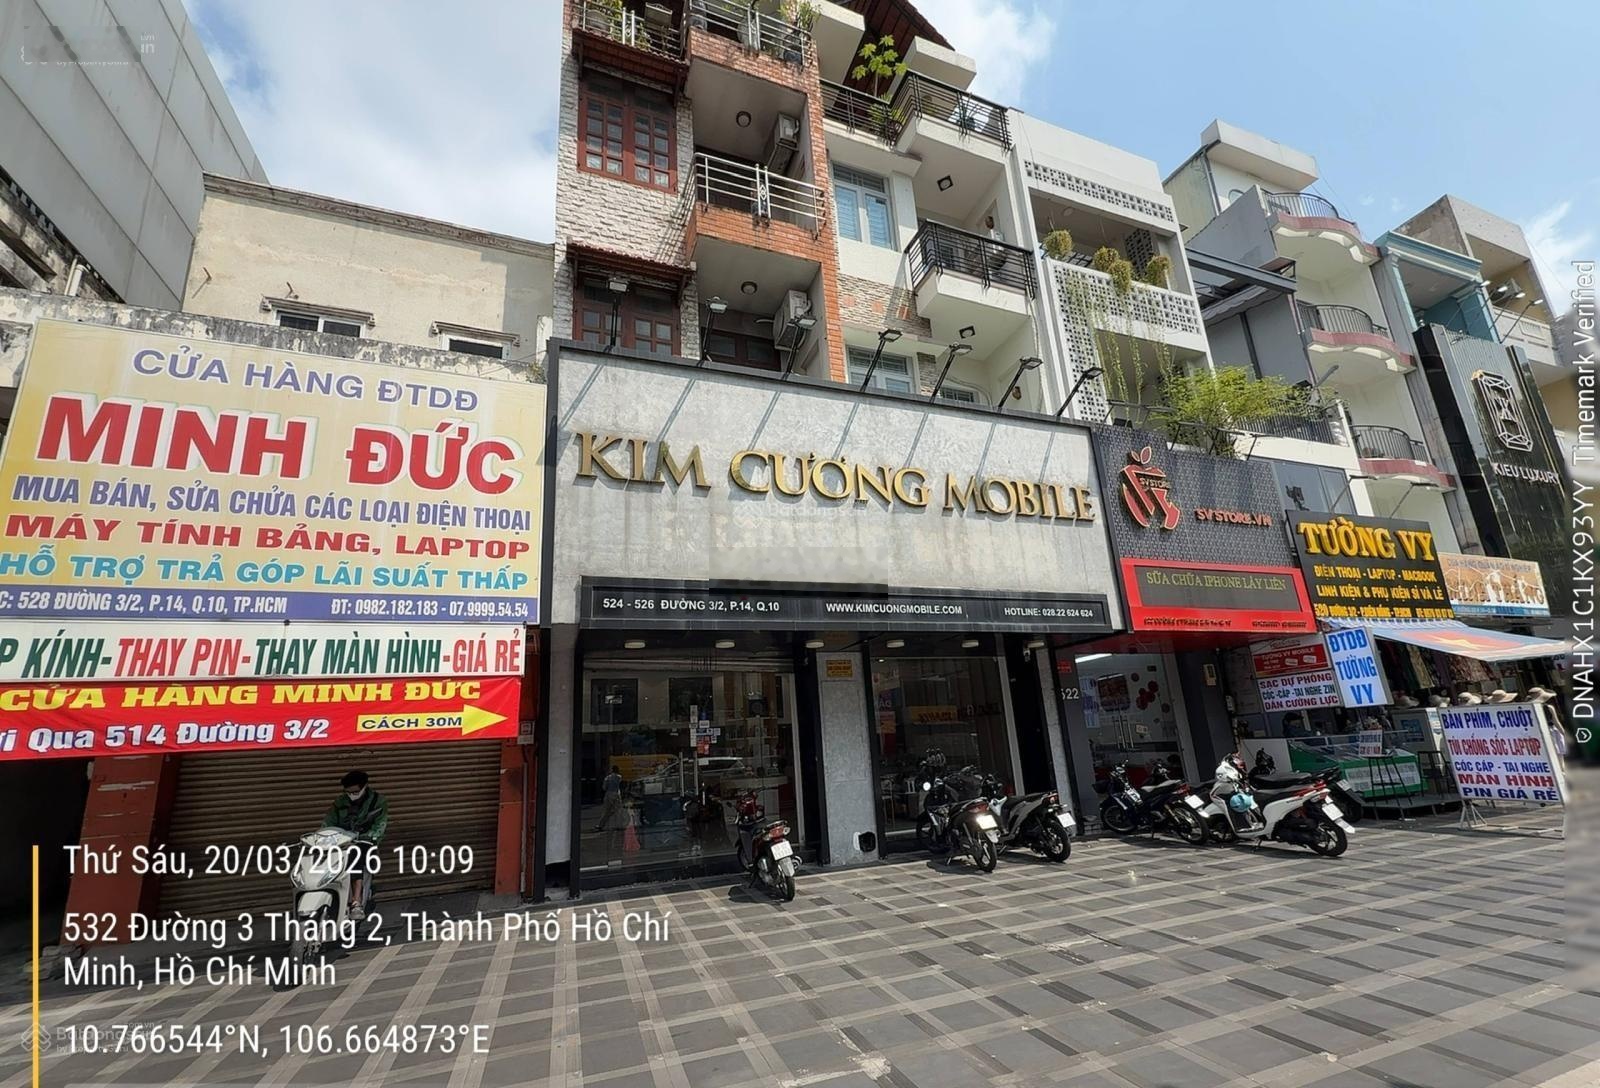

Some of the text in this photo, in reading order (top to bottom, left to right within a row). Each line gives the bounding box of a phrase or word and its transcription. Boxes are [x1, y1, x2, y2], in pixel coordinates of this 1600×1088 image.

[133, 344, 478, 411] CỬA HÀNG ĐTDĐ
[37, 396, 515, 495] MINH ĐỨC
[576, 432, 711, 488] KIM
[943, 473, 1096, 522] MOBILE
[12, 475, 80, 504] MUA
[89, 477, 156, 512] BÁN,
[167, 479, 220, 513] SỬA
[305, 492, 353, 521] CÁC
[360, 499, 410, 528] LOẠI
[416, 500, 466, 531] ĐIỆN
[474, 507, 531, 535] THOẠI
[5, 513, 530, 559] MÁY TÍNH BẢNG, LAPTOP
[1394, 530, 1435, 561] VY
[0, 545, 528, 590] HỖ TRỢ TRẢ GÓP LÃI SUẤT THẤP
[1367, 568, 1396, 581] LAPTOP
[17, 592, 50, 610] 528
[54, 589, 111, 612] ĐƯỜNG
[116, 594, 145, 614] 3/2,
[149, 595, 187, 614] P.14,
[191, 596, 228, 615] Q.10,
[234, 596, 288, 614] TP.HCM
[331, 599, 352, 615] ĐT:
[354, 599, 438, 616] 0982.182.183
[449, 601, 529, 617] 07.9999.54.54
[602, 598, 624, 609] 524
[634, 599, 655, 610] 526
[660, 597, 705, 610] ĐƯỜNG
[708, 600, 727, 612] 3/2,
[730, 601, 754, 613] P.14,
[756, 602, 780, 612] Q.10
[826, 603, 963, 615] WWW.KIMCUONGMOBILE.COM
[1004, 607, 1041, 616] HOTLINE:
[321, 631, 380, 674] MÀN
[494, 628, 521, 672] RẺ
[1328, 629, 1368, 653] ĐTDĐ
[272, 683, 393, 704] MINH
[404, 679, 481, 701] ĐỨC
[1350, 683, 1374, 705] VY
[28, 727, 96, 753] Qua
[105, 724, 166, 747] 514
[176, 721, 275, 745] Đường
[283, 718, 329, 740] 3/2
[361, 716, 462, 729] CÁCH 30M
[1508, 737, 1541, 756] LAPTOP
[1503, 762, 1519, 773] TAI
[1520, 762, 1550, 773] NGHE
[1462, 787, 1492, 798] PIN
